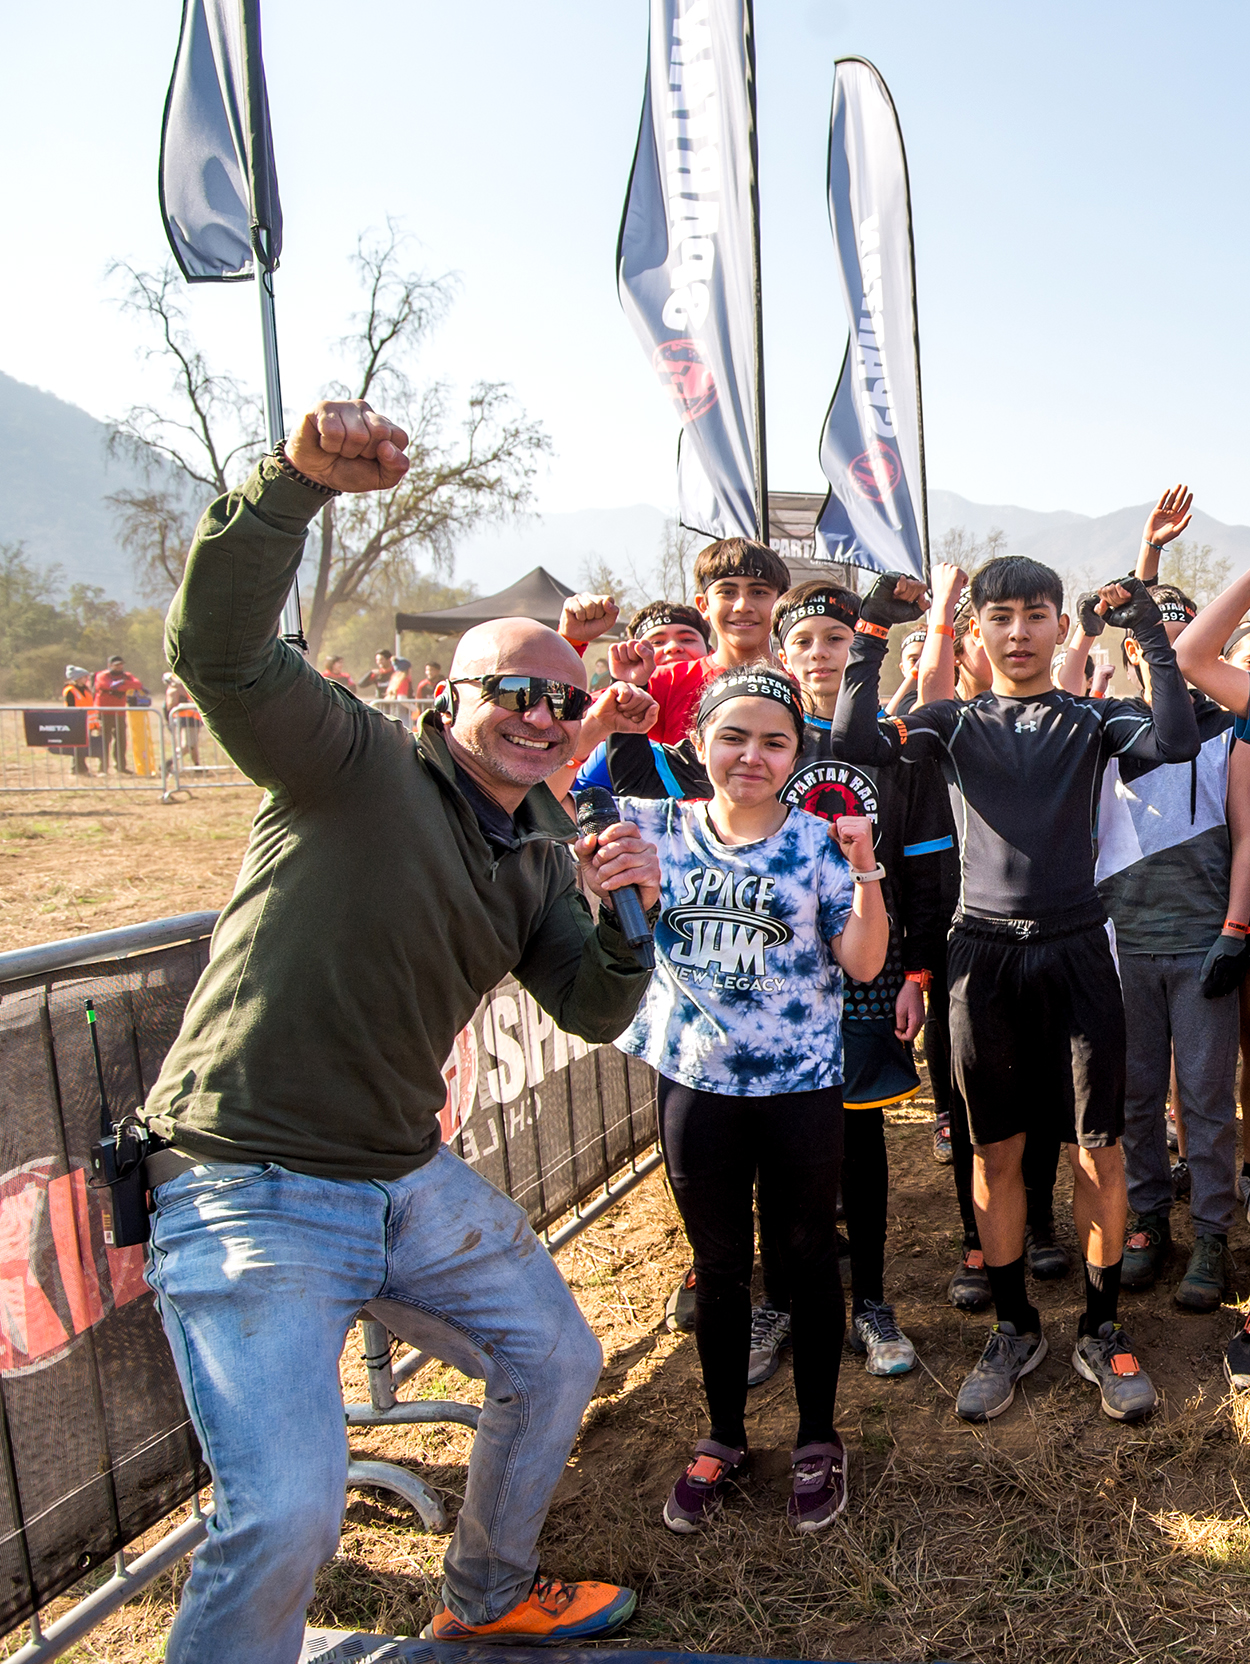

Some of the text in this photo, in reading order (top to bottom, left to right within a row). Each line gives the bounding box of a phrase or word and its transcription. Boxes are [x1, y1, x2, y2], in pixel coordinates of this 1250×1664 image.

[770, 538, 815, 558] PART
[790, 604, 826, 622] 3589
[727, 675, 792, 696] SPARTAN
[747, 683, 791, 705] 3586
[785, 767, 850, 807] PARTAN
[680, 867, 777, 915] SPACE
[669, 919, 767, 977] JAM
[712, 973, 787, 994] LEGACY
[483, 988, 603, 1104] SPA
